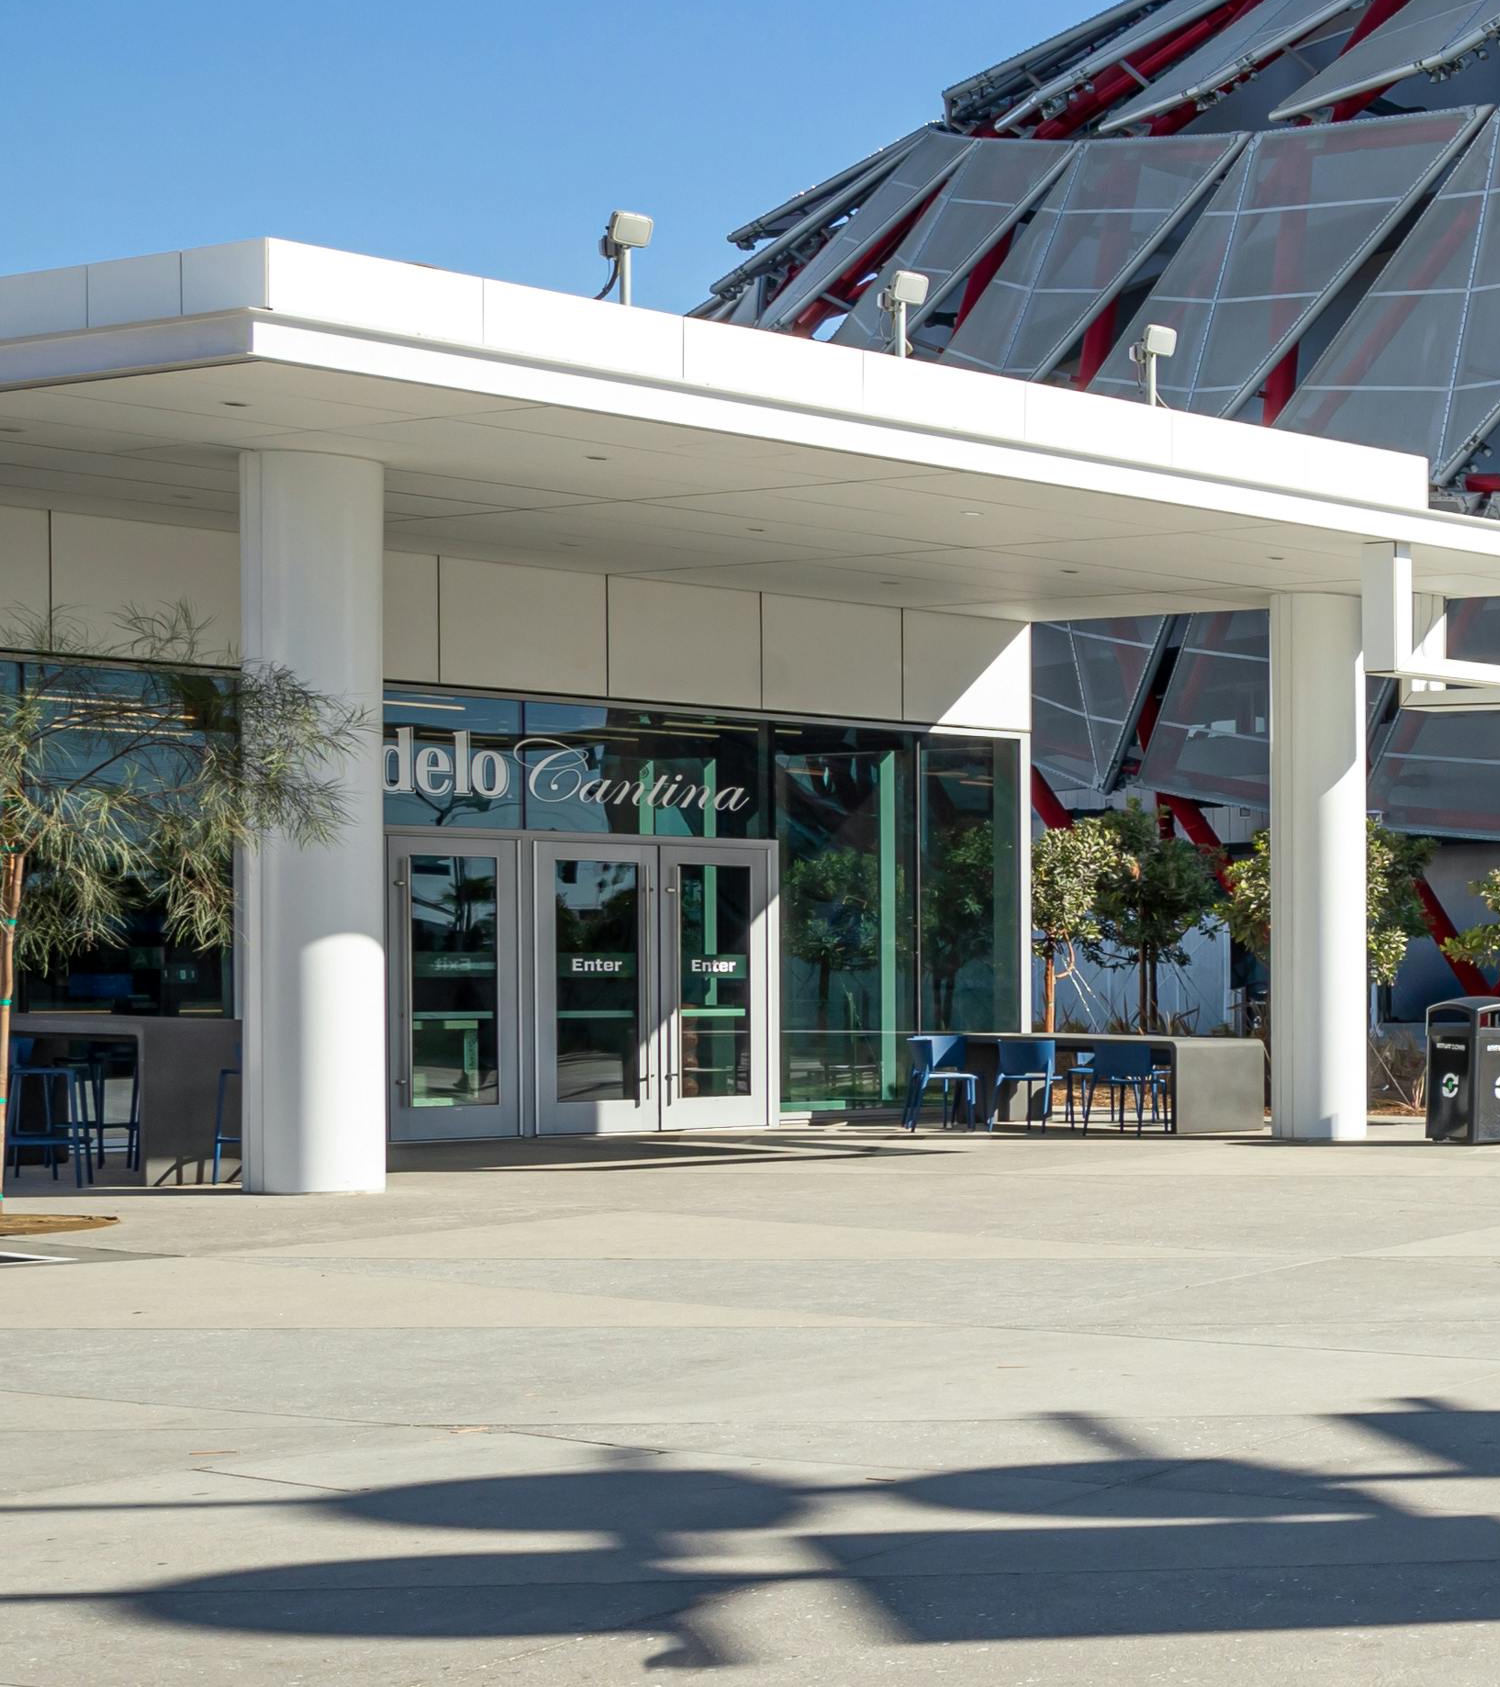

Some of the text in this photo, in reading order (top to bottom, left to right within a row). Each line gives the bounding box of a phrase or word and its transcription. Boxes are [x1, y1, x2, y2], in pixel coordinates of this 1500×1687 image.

[513, 737, 751, 813] Cantina
[571, 958, 623, 972] Enter
[691, 959, 736, 973] Enter
